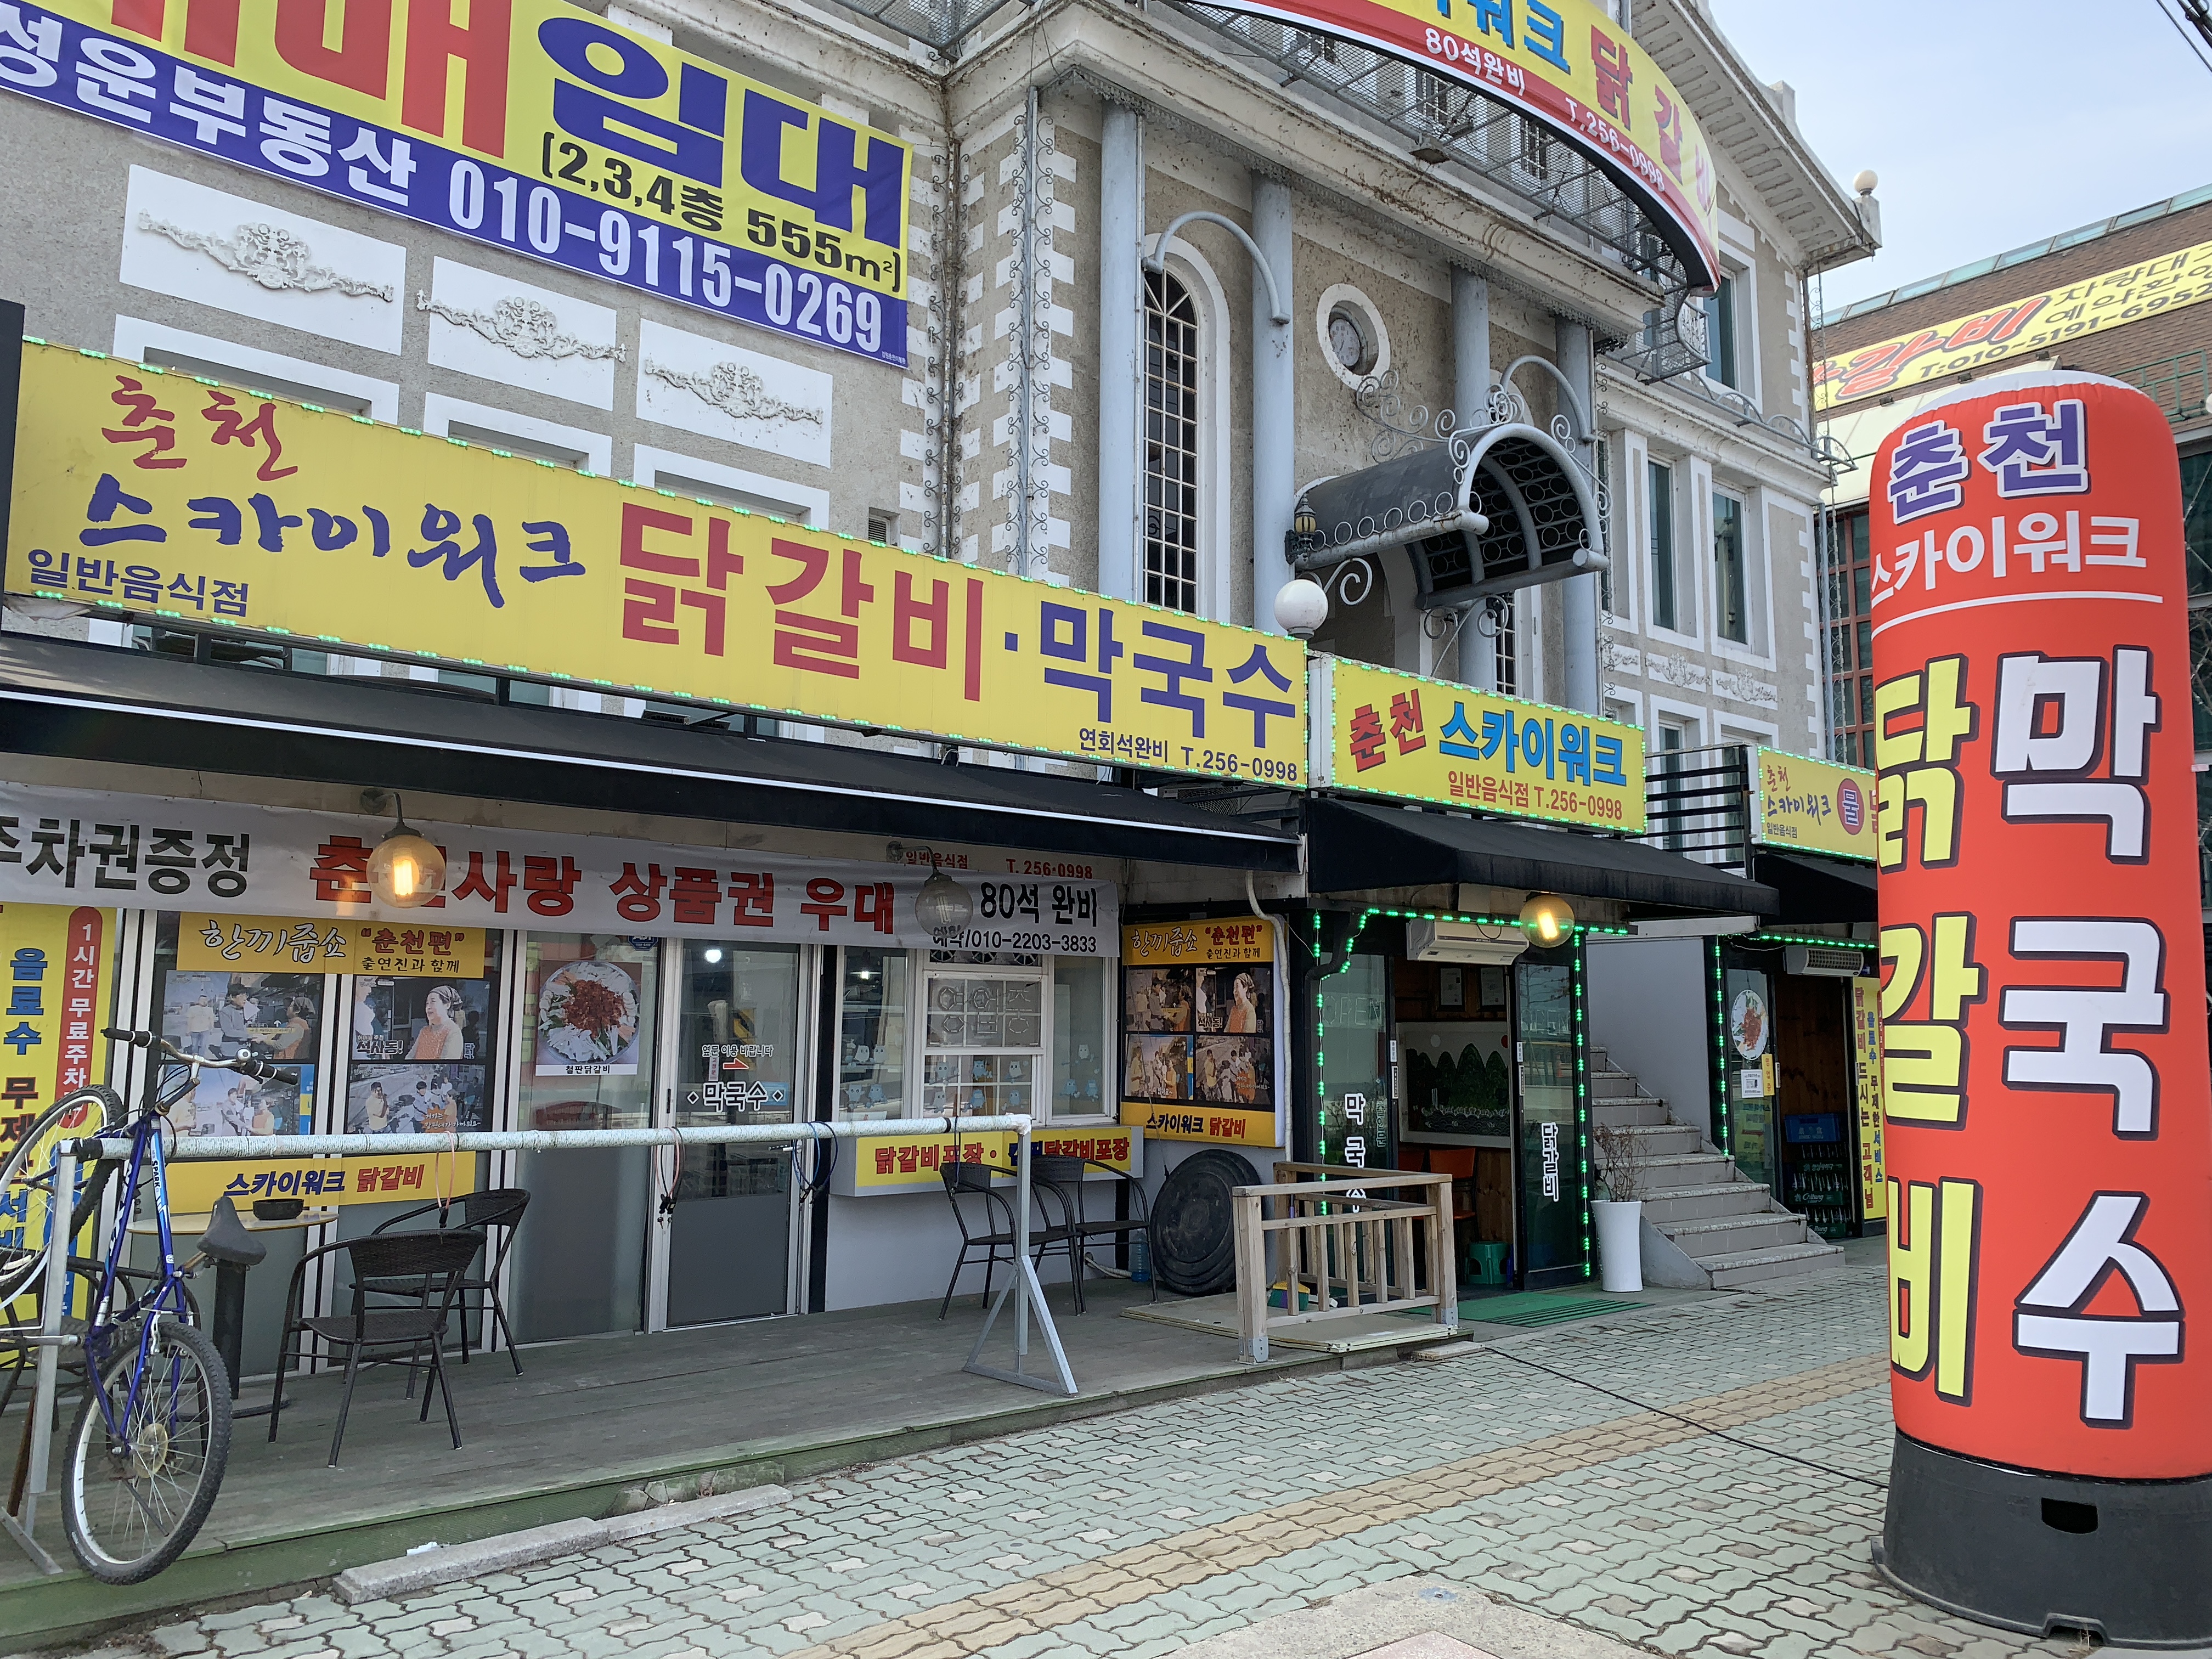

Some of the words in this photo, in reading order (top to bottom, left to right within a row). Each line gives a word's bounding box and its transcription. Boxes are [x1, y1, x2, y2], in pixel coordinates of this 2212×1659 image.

[538, 17, 904, 250] 임대
[1425, 28, 1525, 96] 80석완비
[1565, 97, 1665, 192] T.256-0998
[0, 8, 416, 207] 성운부동산
[449, 160, 881, 353] 010-9115-0269
[1813, 295, 2051, 400] 갈비
[101, 375, 298, 481] 춘천
[1887, 399, 2090, 526] 춘천
[80, 473, 586, 608] 스카이워크
[1871, 510, 2146, 609] 스카이워크
[27, 548, 250, 617] 일반음식점
[1079, 728, 1169, 763] 연회석완비
[1181, 747, 1298, 782] T.256-0998
[1350, 689, 1426, 772] 춘천
[1439, 701, 1627, 786] 스카이워크
[1448, 771, 1529, 808] 일반음식점
[1534, 786, 1623, 821] T.256-0998
[1767, 764, 1791, 792] 춘천
[1767, 793, 1831, 826] 스카이워크
[905, 850, 968, 870] 일반음식점
[1767, 822, 1798, 839] 일반음식점
[309, 834, 582, 916] 춘사랑
[608, 862, 775, 927] 상품권
[800, 877, 895, 934] 우대
[980, 882, 1040, 924] 80석
[1052, 884, 1097, 927] 완비
[71, 923, 95, 990] 1시간
[199, 919, 347, 963] 한끼줍쇼
[360, 956, 426, 972] 출연진과
[430, 959, 460, 973] 함께
[1131, 926, 1198, 957] 한끼줍쇼
[1205, 947, 1241, 960] 출연진과
[1243, 947, 1261, 959] 함께
[4, 947, 48, 1056] 음료수
[1874, 652, 1987, 1406] 닭갈비
[63, 997, 92, 1111] 무료주차
[357, 1040, 404, 1054] 석사동!
[702, 1045, 720, 1057] 옆문
[721, 1045, 738, 1057] 이용
[740, 1044, 774, 1057] 바랍니다
[1993, 645, 2186, 1427] 막국수
[703, 1080, 769, 1113] 막국수
[1146, 1113, 1204, 1135] 스카이워크
[1209, 1116, 1247, 1139] 닭갈비
[223, 1170, 346, 1198] 스카이워크
[356, 1164, 425, 1193] 닭갈비
[1541, 1122, 1559, 1202] 닭갈비
